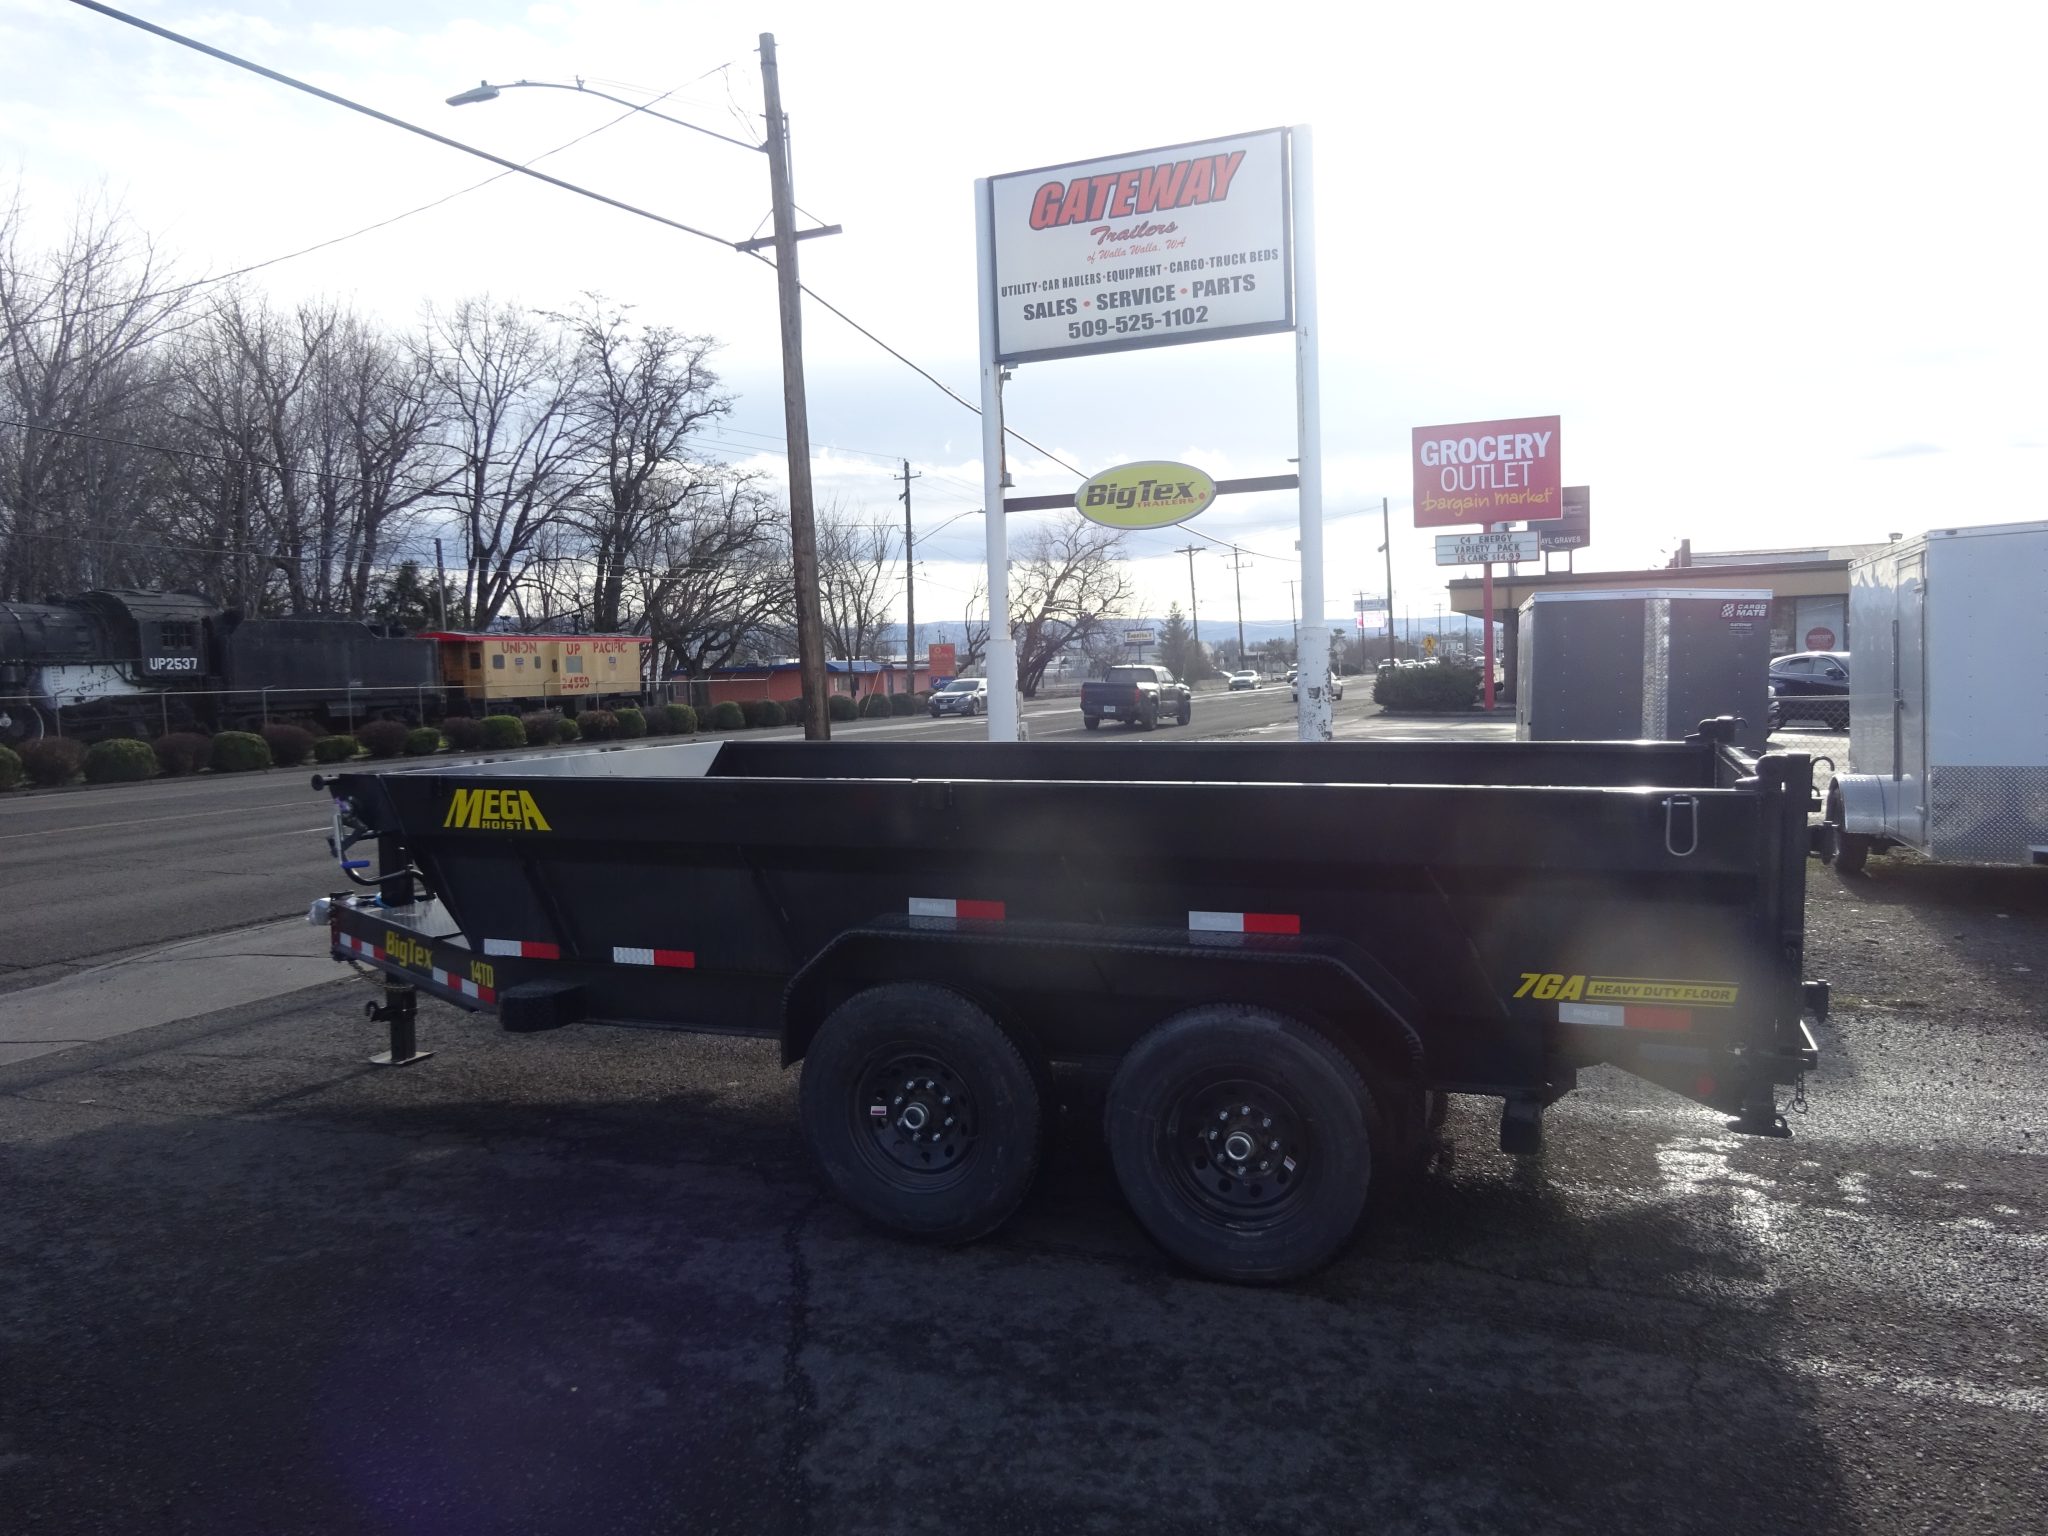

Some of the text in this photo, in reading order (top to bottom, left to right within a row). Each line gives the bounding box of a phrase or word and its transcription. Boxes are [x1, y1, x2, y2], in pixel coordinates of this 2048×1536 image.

[1029, 151, 1246, 230] GATEWAY
[1090, 220, 1179, 246] Trailers
[1087, 251, 1096, 264] of
[1099, 248, 1127, 260] Walla
[1165, 236, 1187, 250] WA
[1001, 248, 1279, 297] UTILITY CAR HAULERS EQUIPMENT CARGO TRUCK BEDS
[1023, 273, 1256, 321] SALES SERVICE PARTS
[1068, 305, 1208, 339] 509-525-1102
[1420, 431, 1552, 467] GROCERY
[1440, 460, 1533, 492] OUTLET
[1085, 479, 1196, 510] BigTex
[1135, 497, 1195, 508] TRAILERS
[1422, 487, 1553, 517] bargain market
[1455, 543, 1520, 554] VARIETY PACK
[1460, 534, 1512, 545] C4 ENERGY
[1554, 535, 1581, 544] GRAVES
[1467, 554, 1489, 563] CANS
[1492, 553, 1521, 562] $14.99
[1736, 609, 1766, 617] MATE
[501, 641, 628, 655] UNION UP PACIFIC
[150, 657, 198, 670] UP2537
[442, 789, 553, 831] MEGA
[481, 820, 522, 830] HOIST
[385, 930, 433, 970] BigTex
[470, 959, 494, 988] 14TD
[1512, 972, 1587, 1001] 7GA
[1593, 984, 1730, 1000] HEAVY DUTY FLOOR
